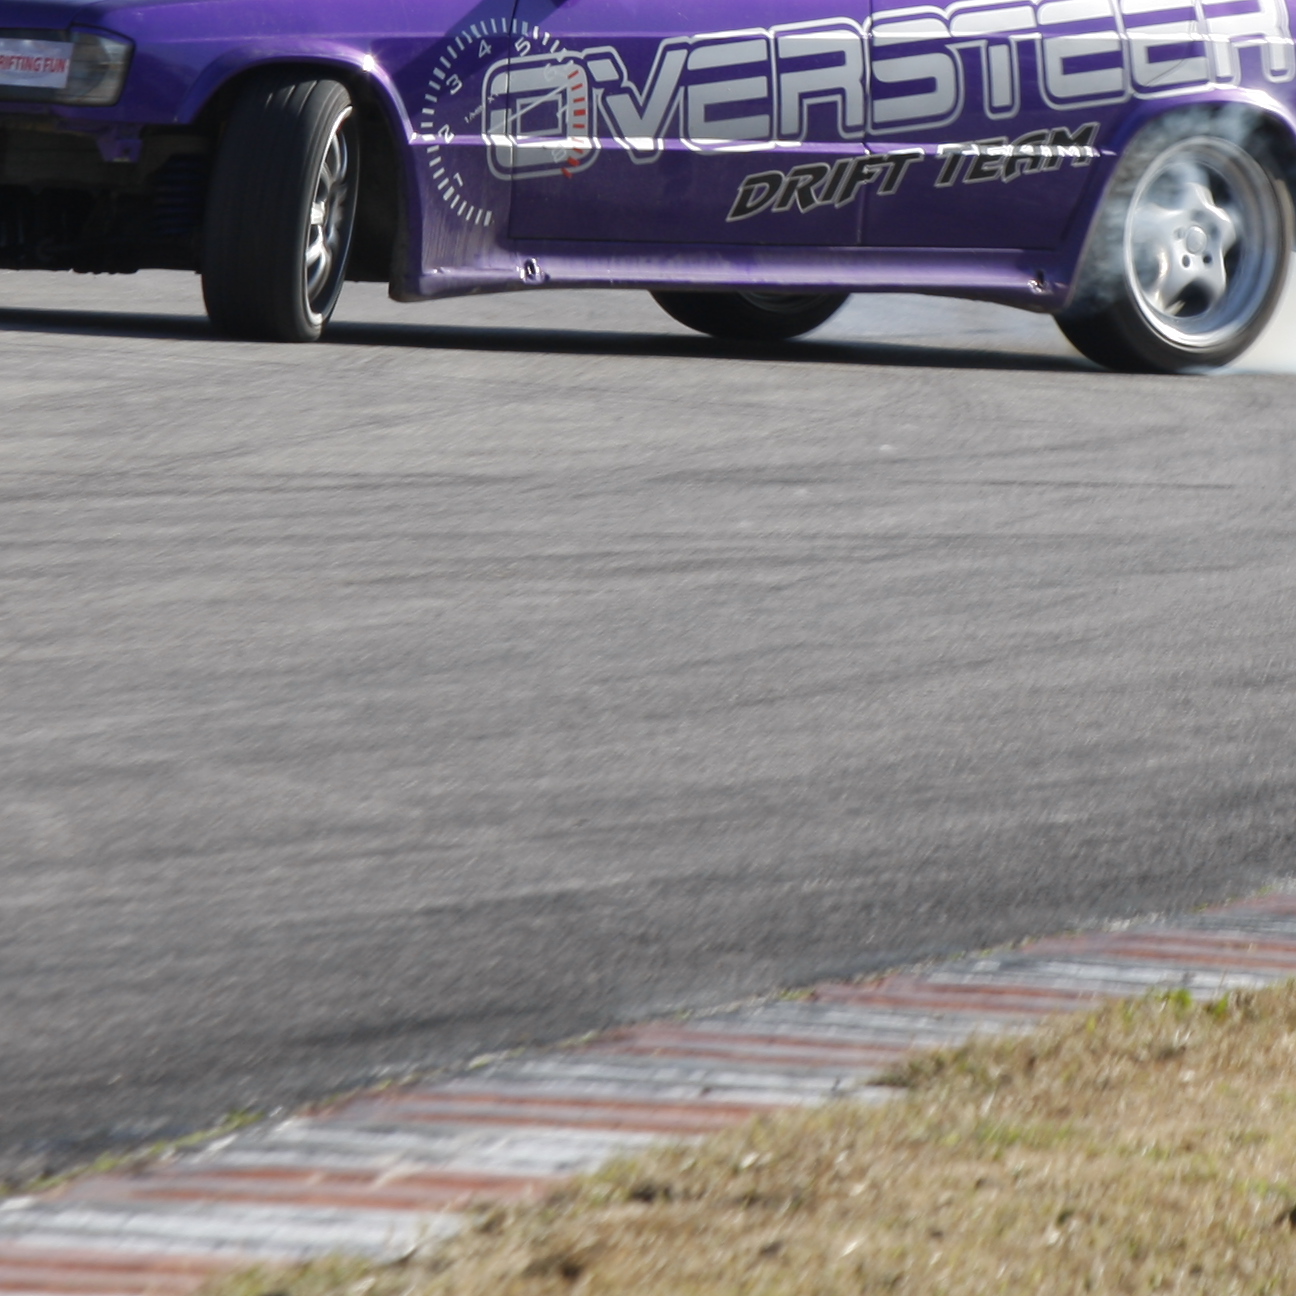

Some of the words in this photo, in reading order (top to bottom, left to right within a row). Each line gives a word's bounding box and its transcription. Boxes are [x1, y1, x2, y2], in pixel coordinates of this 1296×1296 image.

[44, 57, 66, 73] FUN
[725, 151, 925, 222] DRIFT
[934, 122, 1102, 188] TEAM
